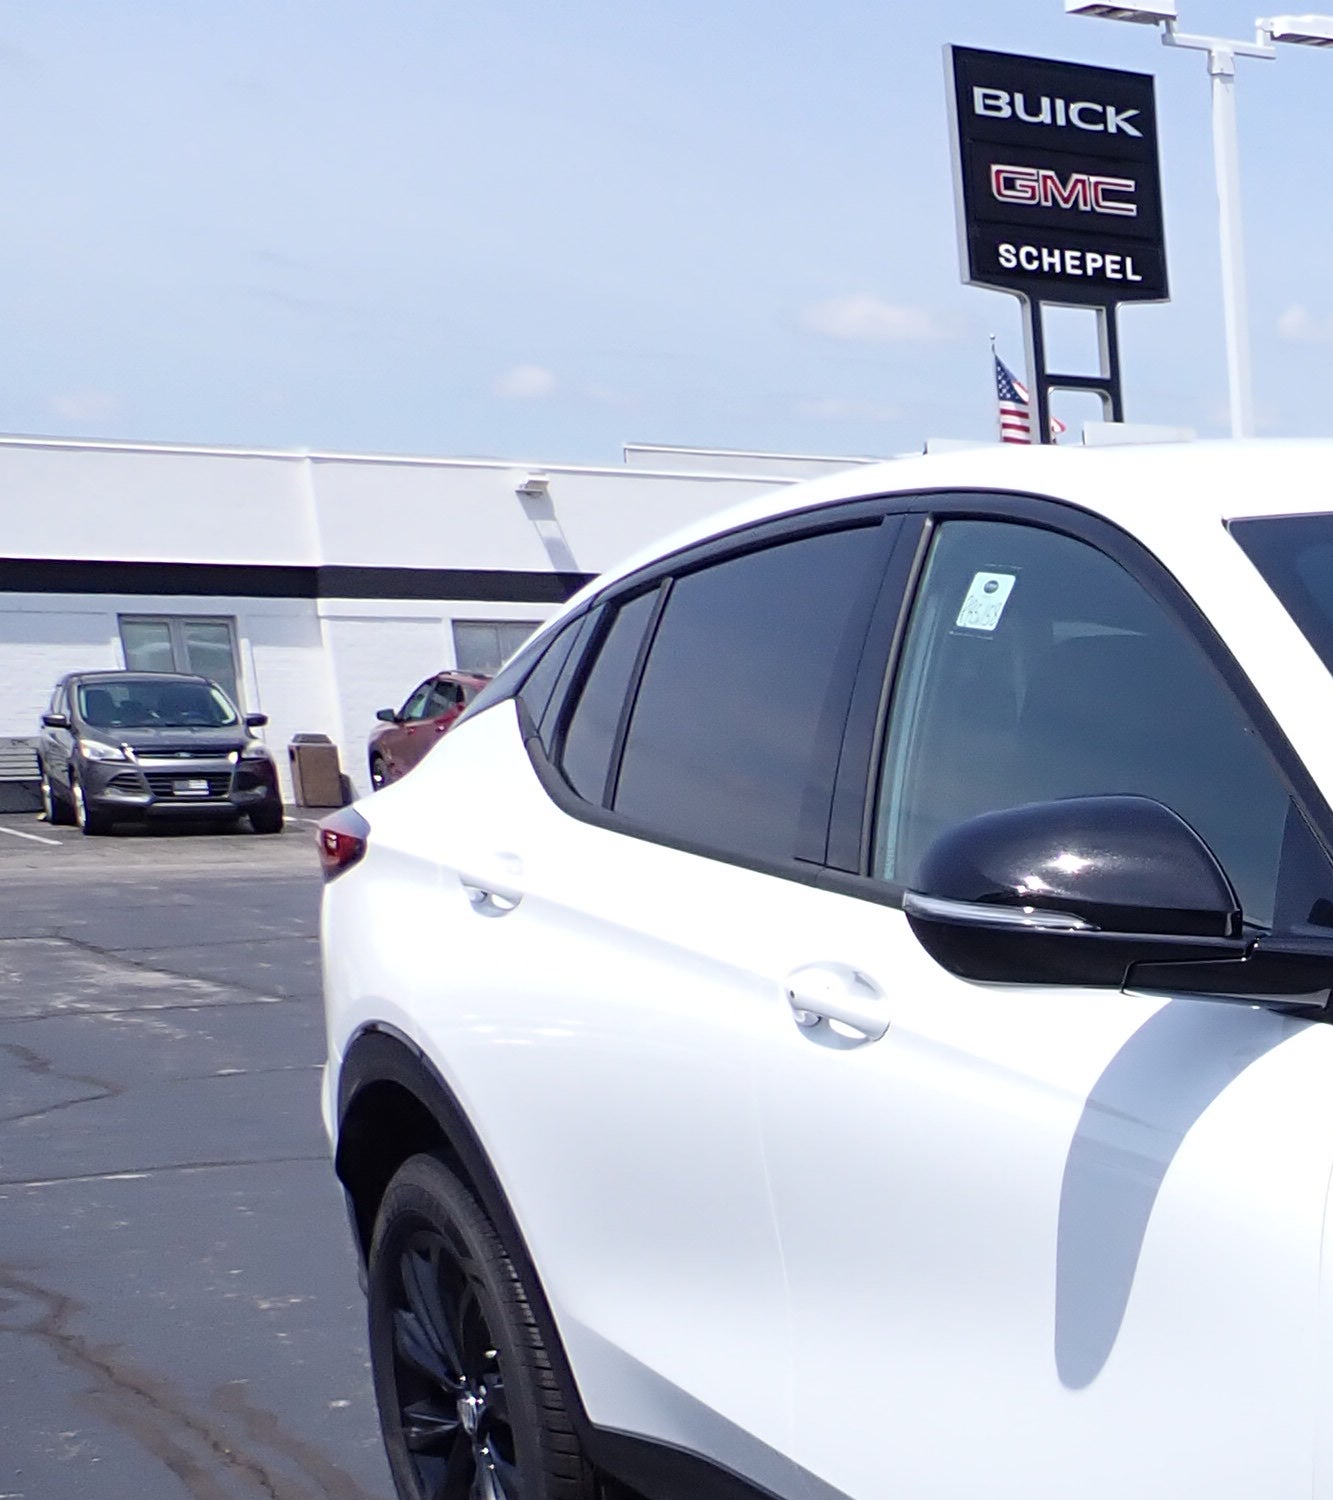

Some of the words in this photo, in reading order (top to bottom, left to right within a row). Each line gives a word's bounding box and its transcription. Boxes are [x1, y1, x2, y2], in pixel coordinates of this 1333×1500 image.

[972, 86, 1143, 137] BUICK
[990, 163, 1137, 217] GMC
[998, 243, 1142, 281] SCHEPEL
